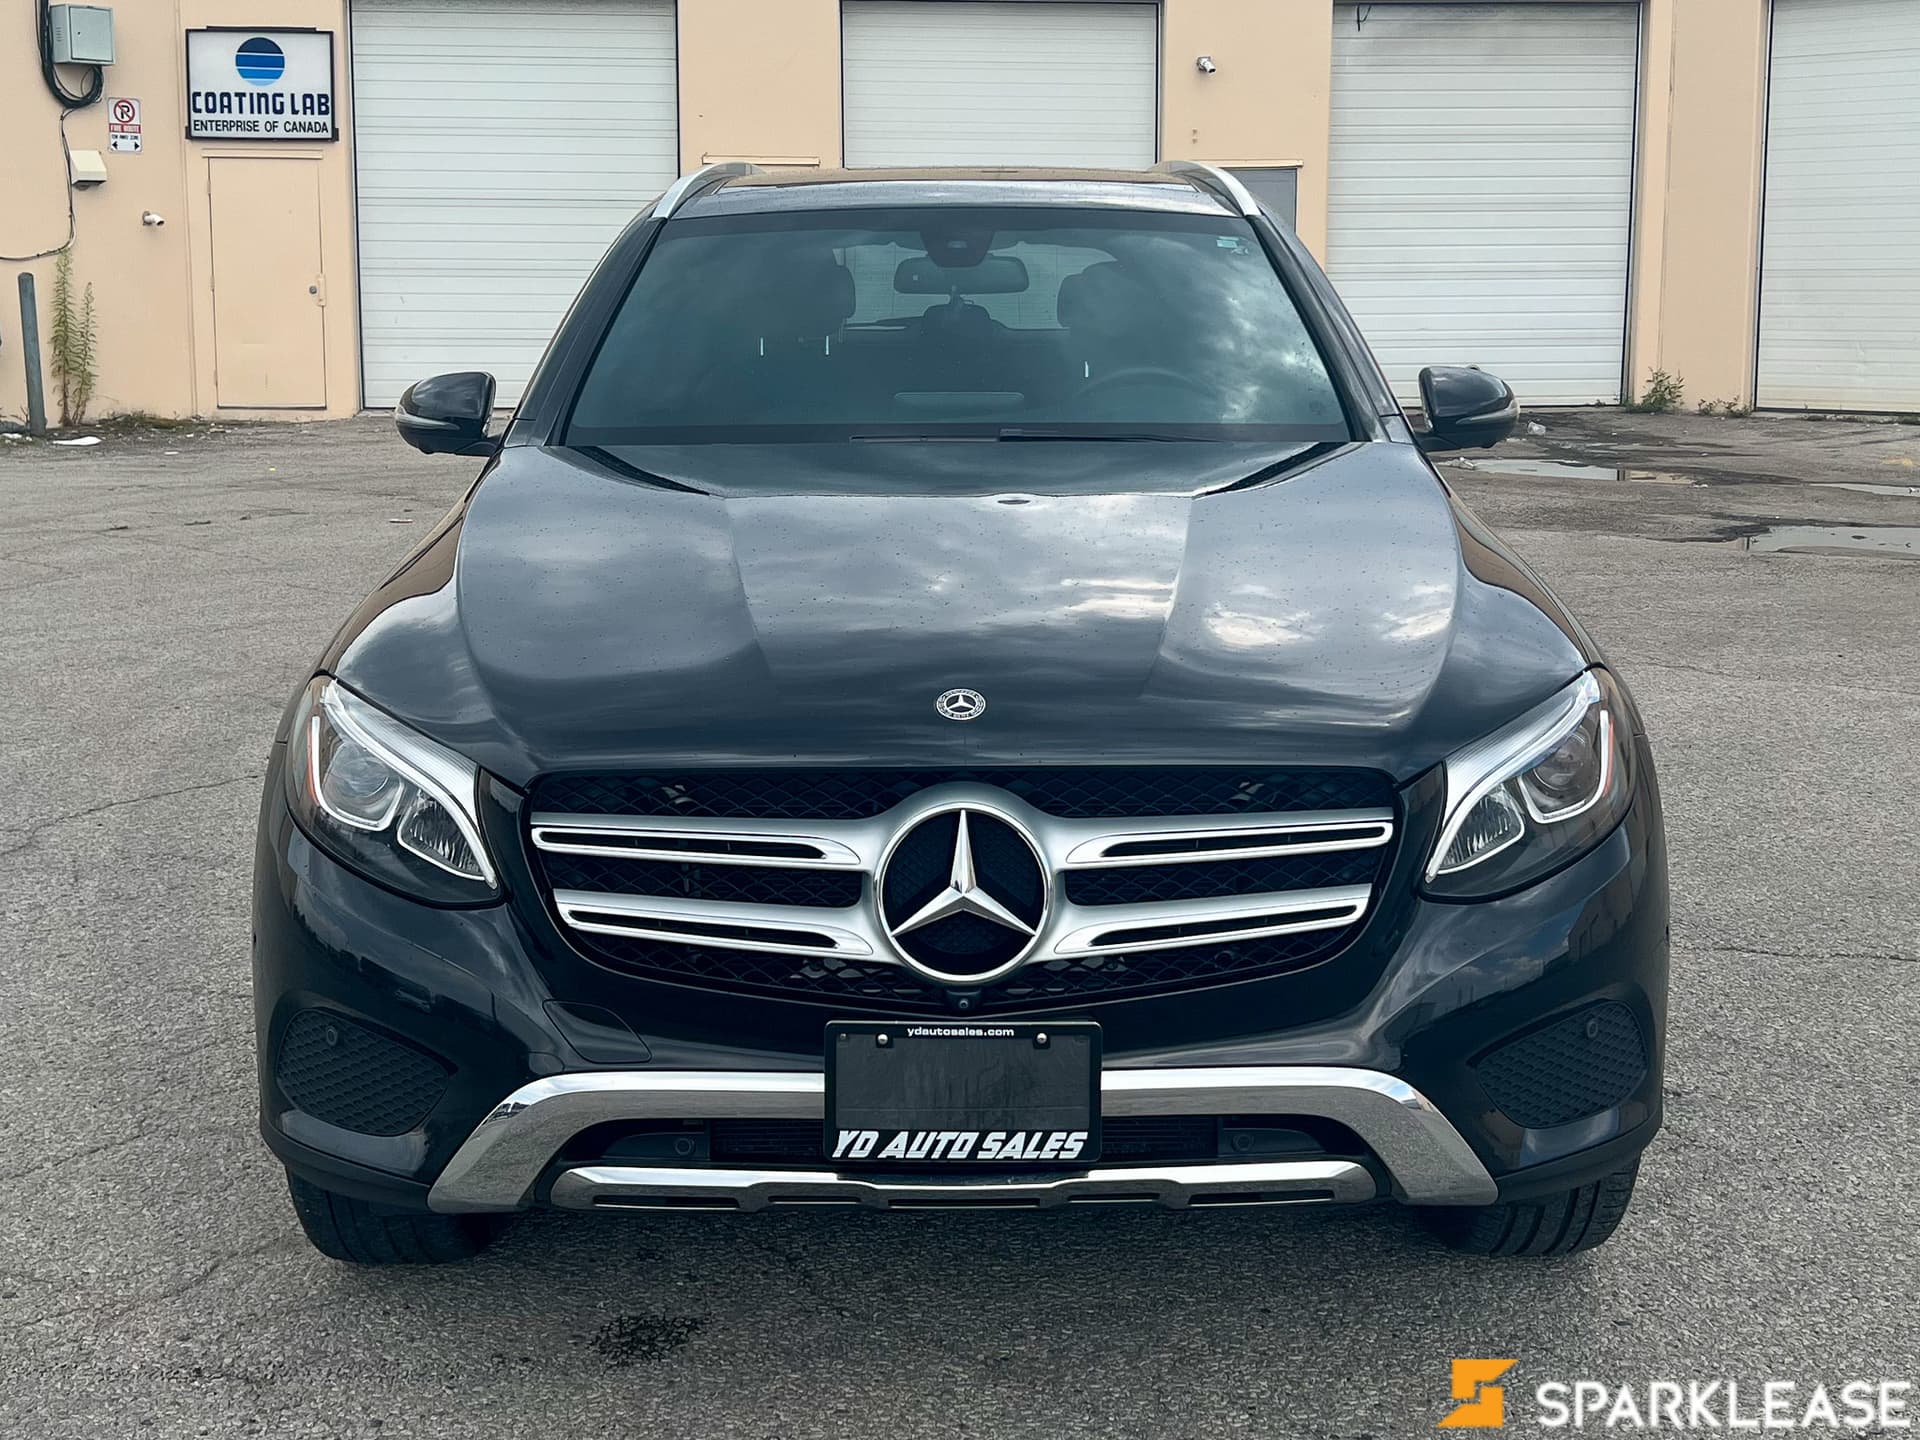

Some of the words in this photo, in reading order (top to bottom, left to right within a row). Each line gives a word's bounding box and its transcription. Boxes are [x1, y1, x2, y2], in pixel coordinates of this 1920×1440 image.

[192, 92, 284, 115] COATING
[290, 93, 330, 115] LAB
[193, 120, 260, 132] ENTERPRISE
[264, 121, 278, 133] OF
[284, 121, 328, 133] CANADA
[907, 1026, 1015, 1038] ydautosales.com
[832, 1130, 880, 1159] YD
[877, 1131, 980, 1159] AUTO
[976, 1131, 1088, 1160] SALES
